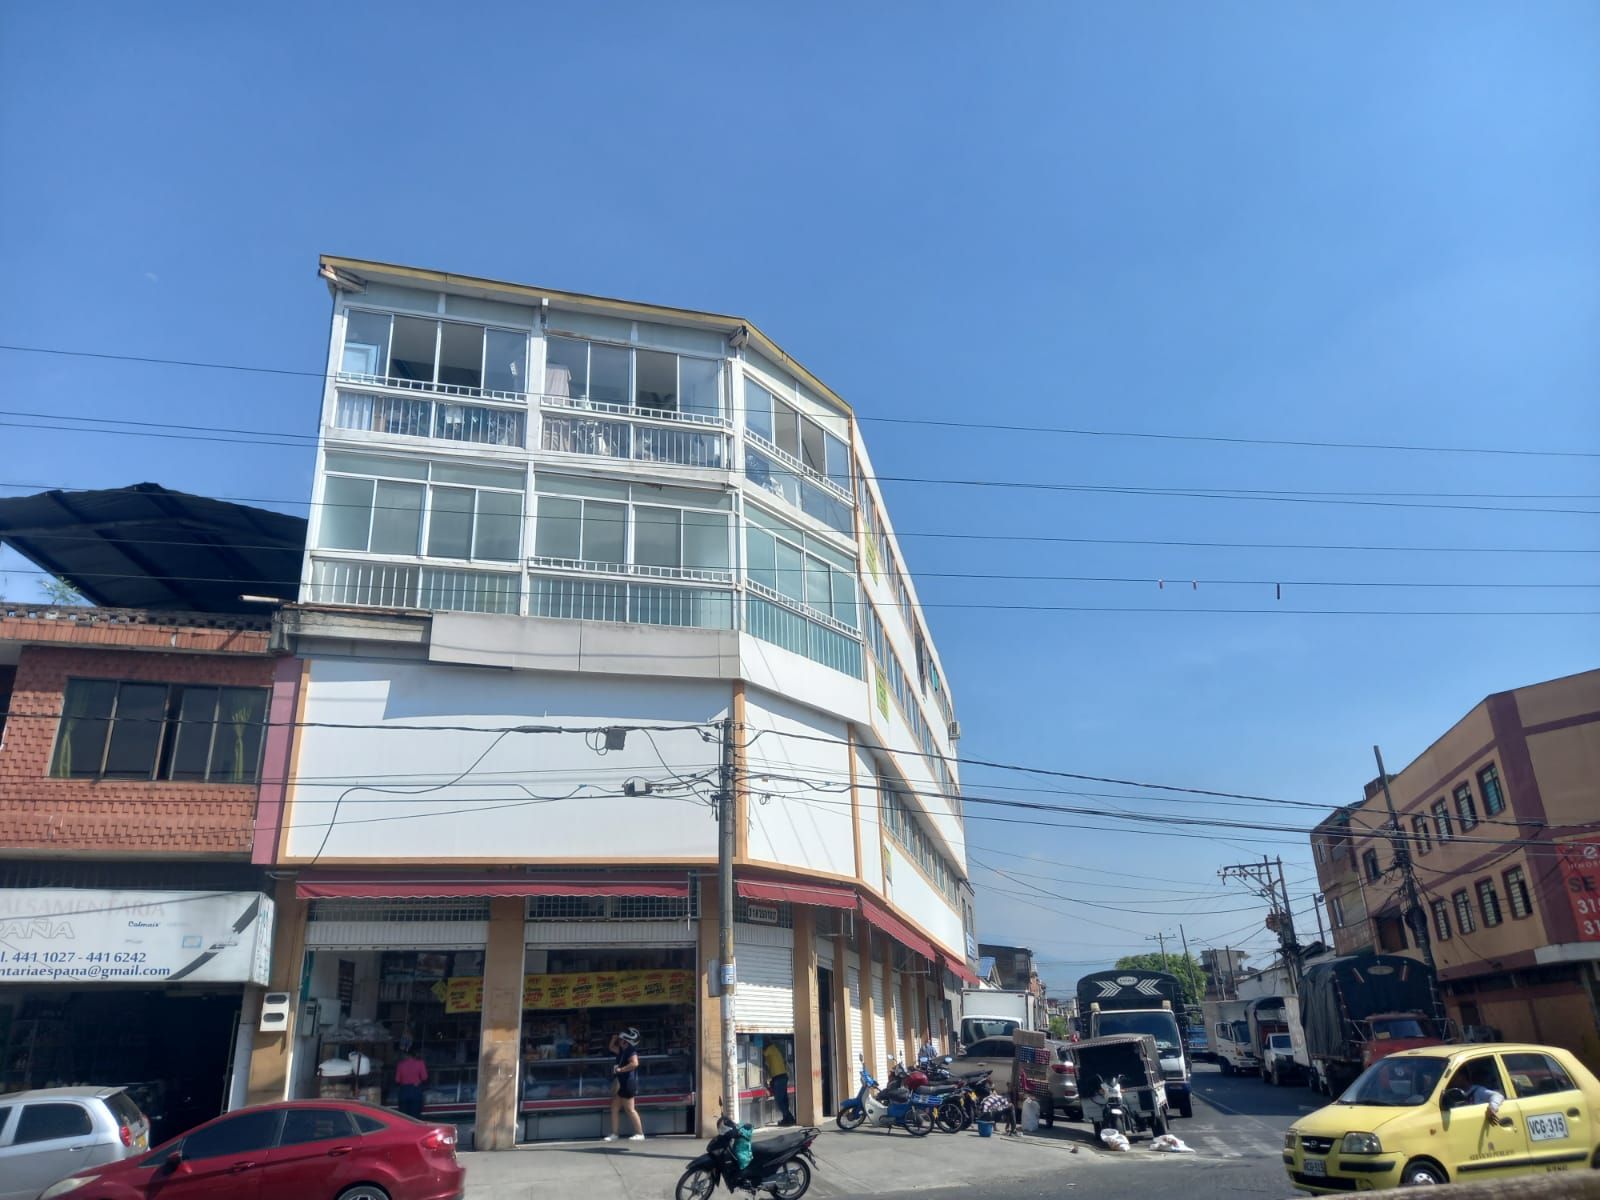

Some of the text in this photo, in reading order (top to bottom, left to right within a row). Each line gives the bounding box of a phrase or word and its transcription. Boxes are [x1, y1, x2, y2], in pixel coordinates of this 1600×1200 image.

[1568, 876, 1597, 893] SE
[12, 951, 38, 963] 441
[43, 951, 76, 963] 1027
[86, 951, 111, 963] 441
[113, 951, 147, 963] 6242
